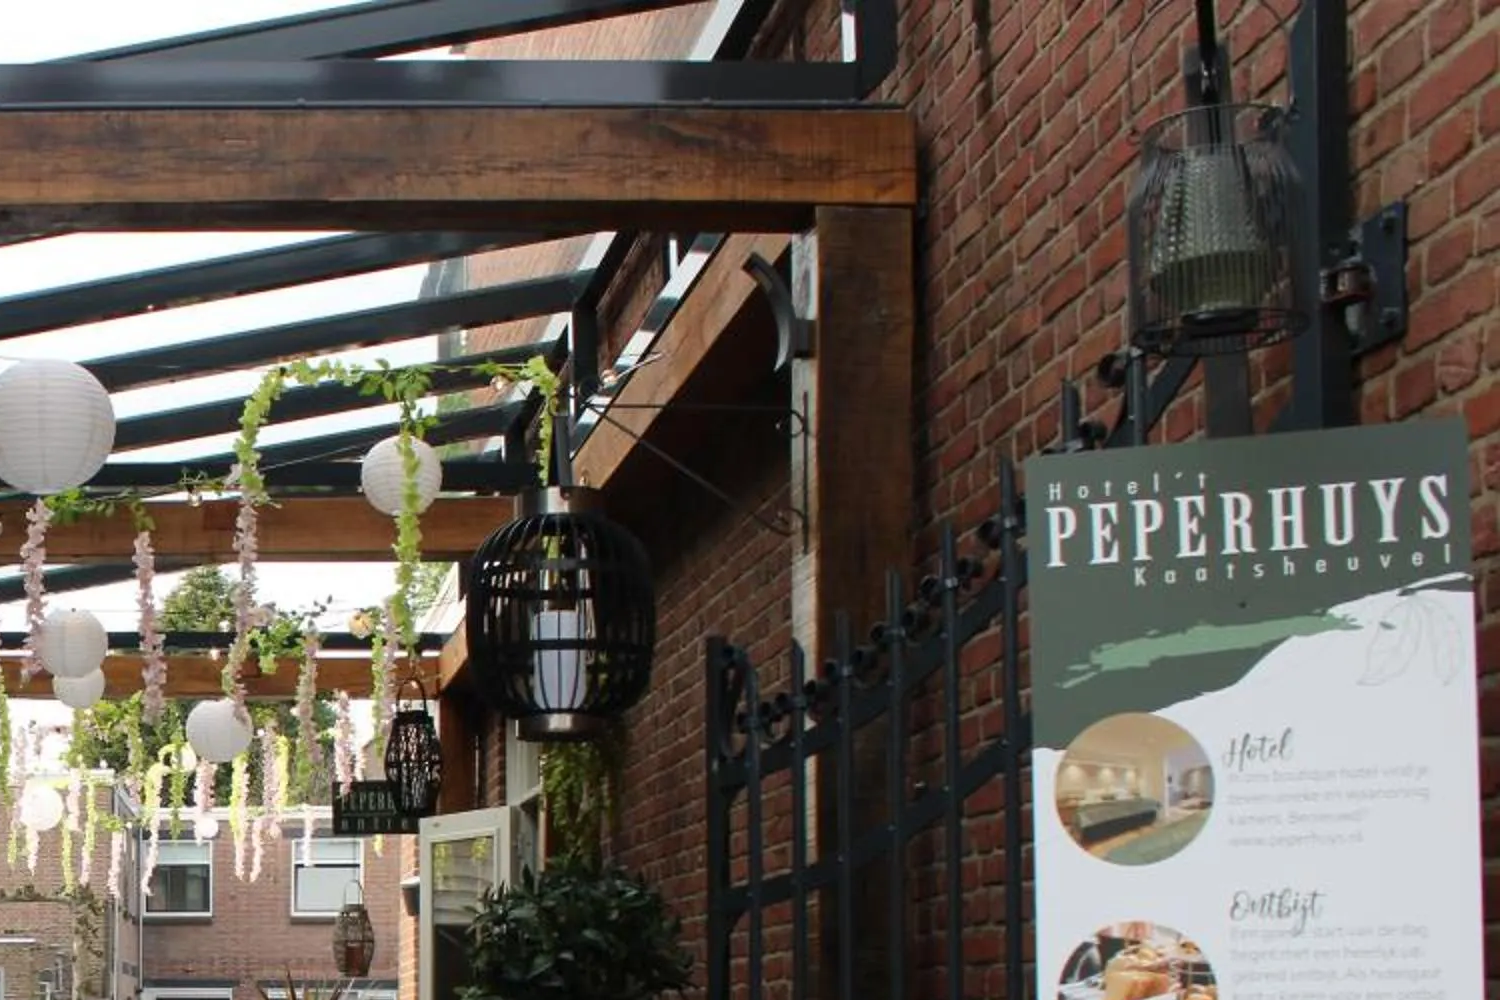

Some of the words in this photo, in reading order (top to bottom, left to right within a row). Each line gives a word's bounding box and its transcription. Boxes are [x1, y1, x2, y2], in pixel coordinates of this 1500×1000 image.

[1045, 474, 1452, 567] PEPERHUYS
[1134, 543, 1452, 587] Kaatsheuvel
[1221, 726, 1294, 772] Hotel
[1230, 887, 1328, 937] Ontbijt
